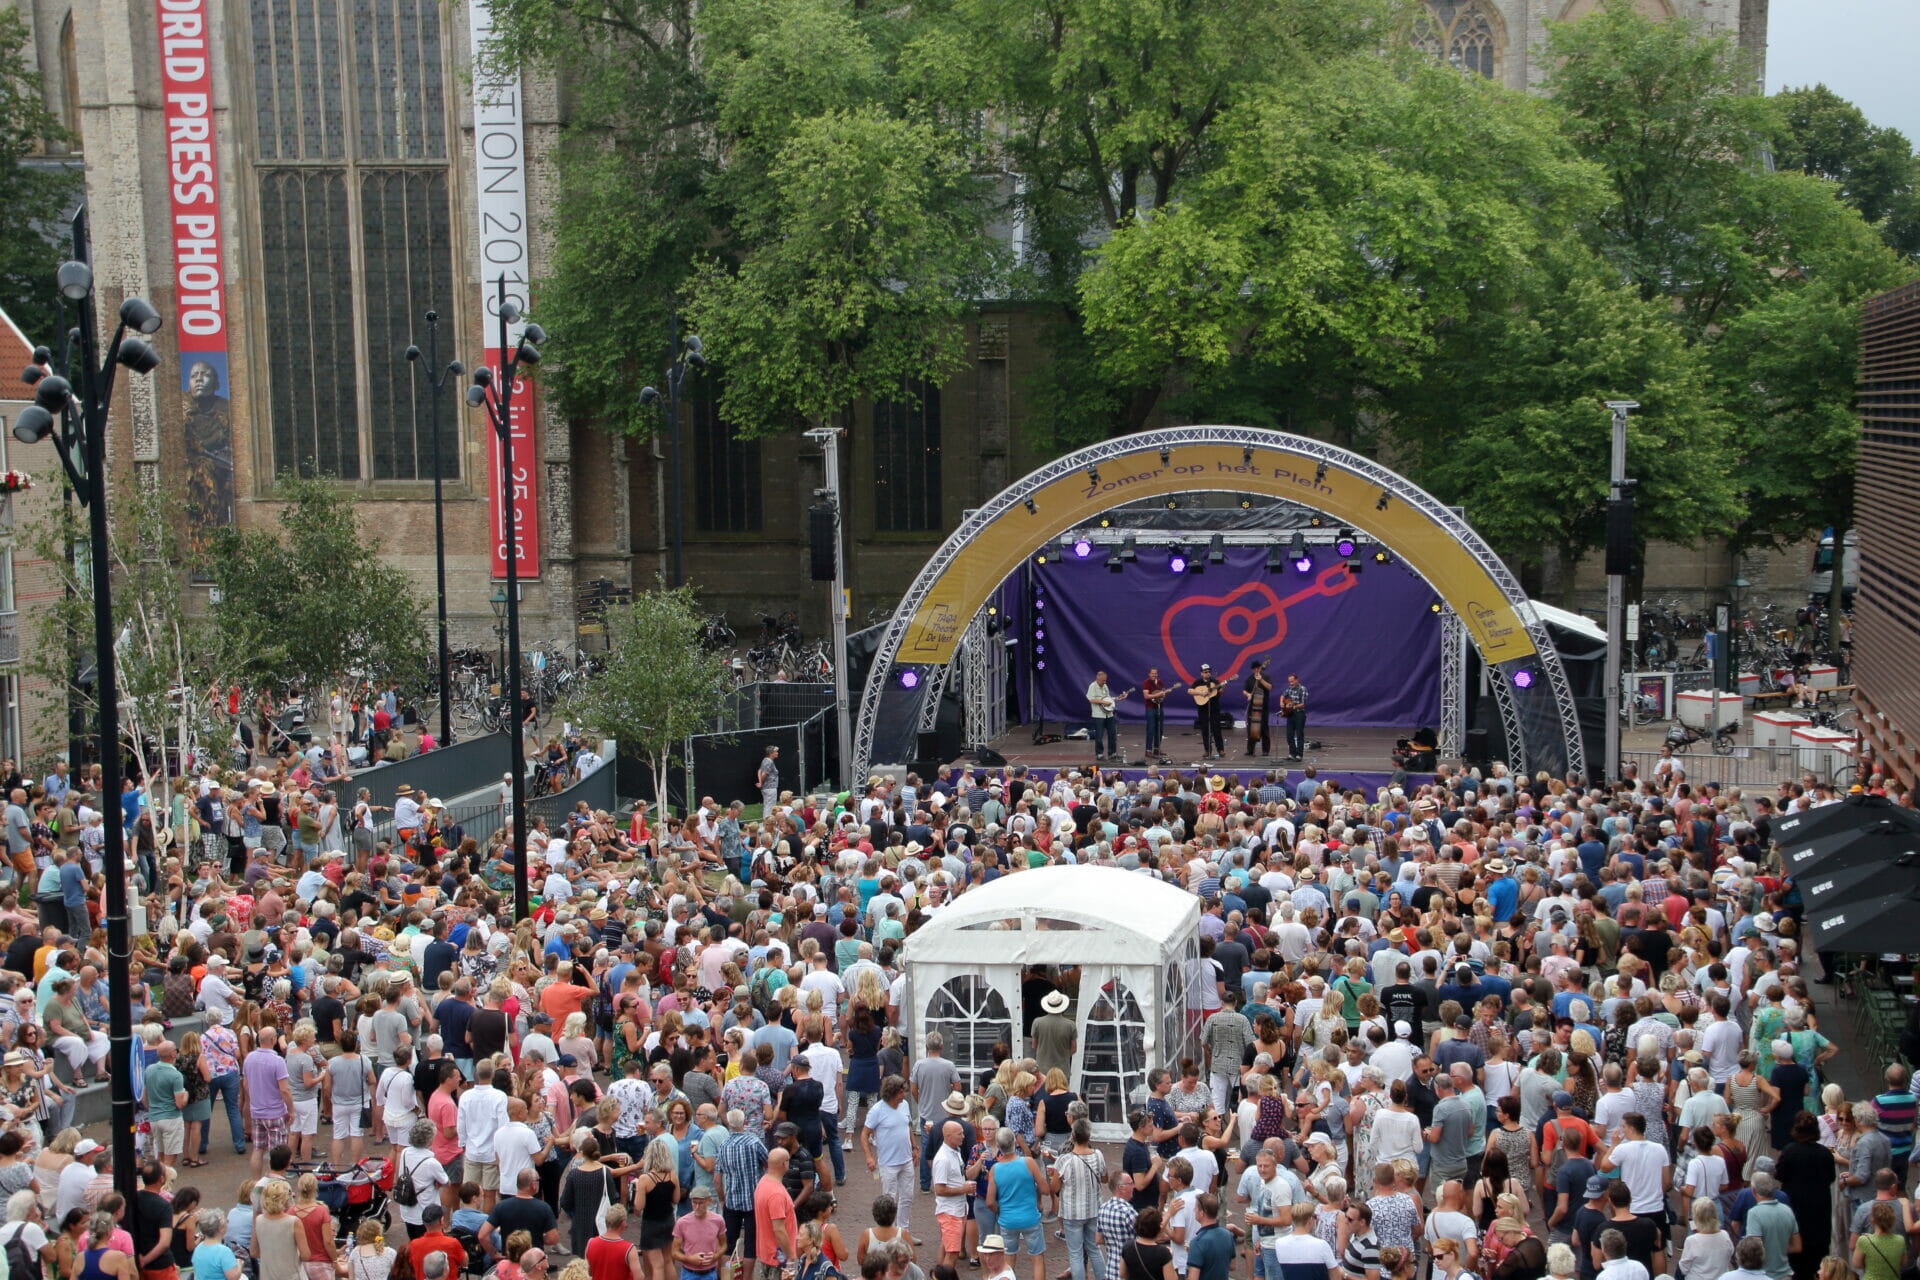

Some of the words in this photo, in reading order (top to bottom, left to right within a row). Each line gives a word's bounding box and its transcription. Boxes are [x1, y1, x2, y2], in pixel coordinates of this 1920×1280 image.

[168, 93, 215, 204] PRESS
[176, 215, 222, 335] PHOTO
[483, 212, 525, 317] 2019
[1081, 468, 1167, 499] Zomer
[1173, 464, 1205, 477] op
[1218, 461, 1262, 476] het
[1274, 468, 1333, 495] Plein
[926, 633, 936, 641] De
[933, 624, 958, 632] Theater
